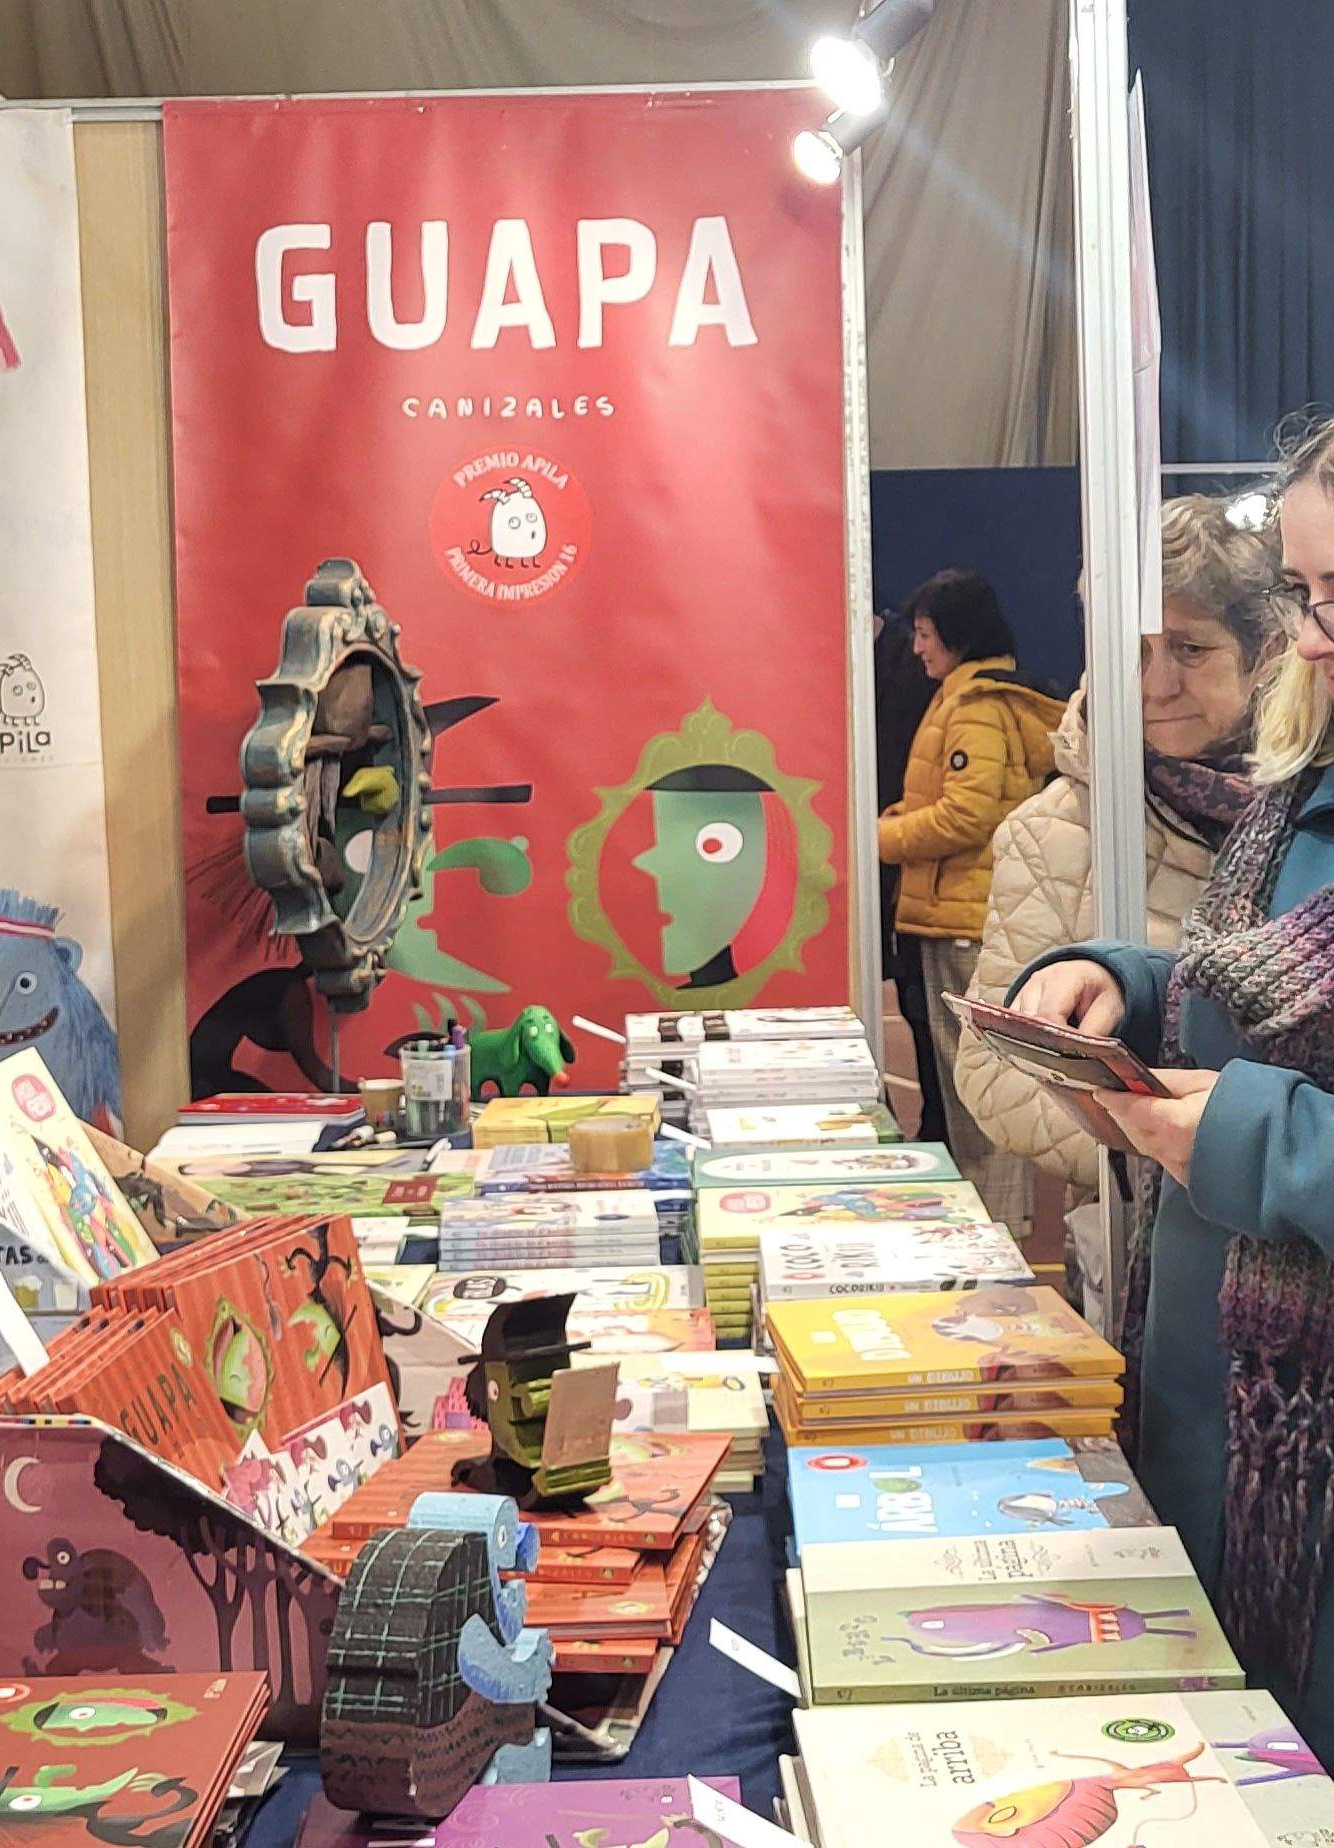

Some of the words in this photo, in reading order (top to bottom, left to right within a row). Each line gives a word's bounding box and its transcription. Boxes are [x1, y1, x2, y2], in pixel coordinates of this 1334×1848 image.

[254, 215, 760, 354] GUAPA
[401, 394, 616, 421] CANIZALES
[453, 451, 520, 488] PREMIO
[522, 454, 569, 490] APILA
[445, 546, 497, 598] PRIMERA
[559, 545, 579, 563] 16
[119, 1362, 197, 1447] GUAPA
[931, 1730, 976, 1784] arriba
